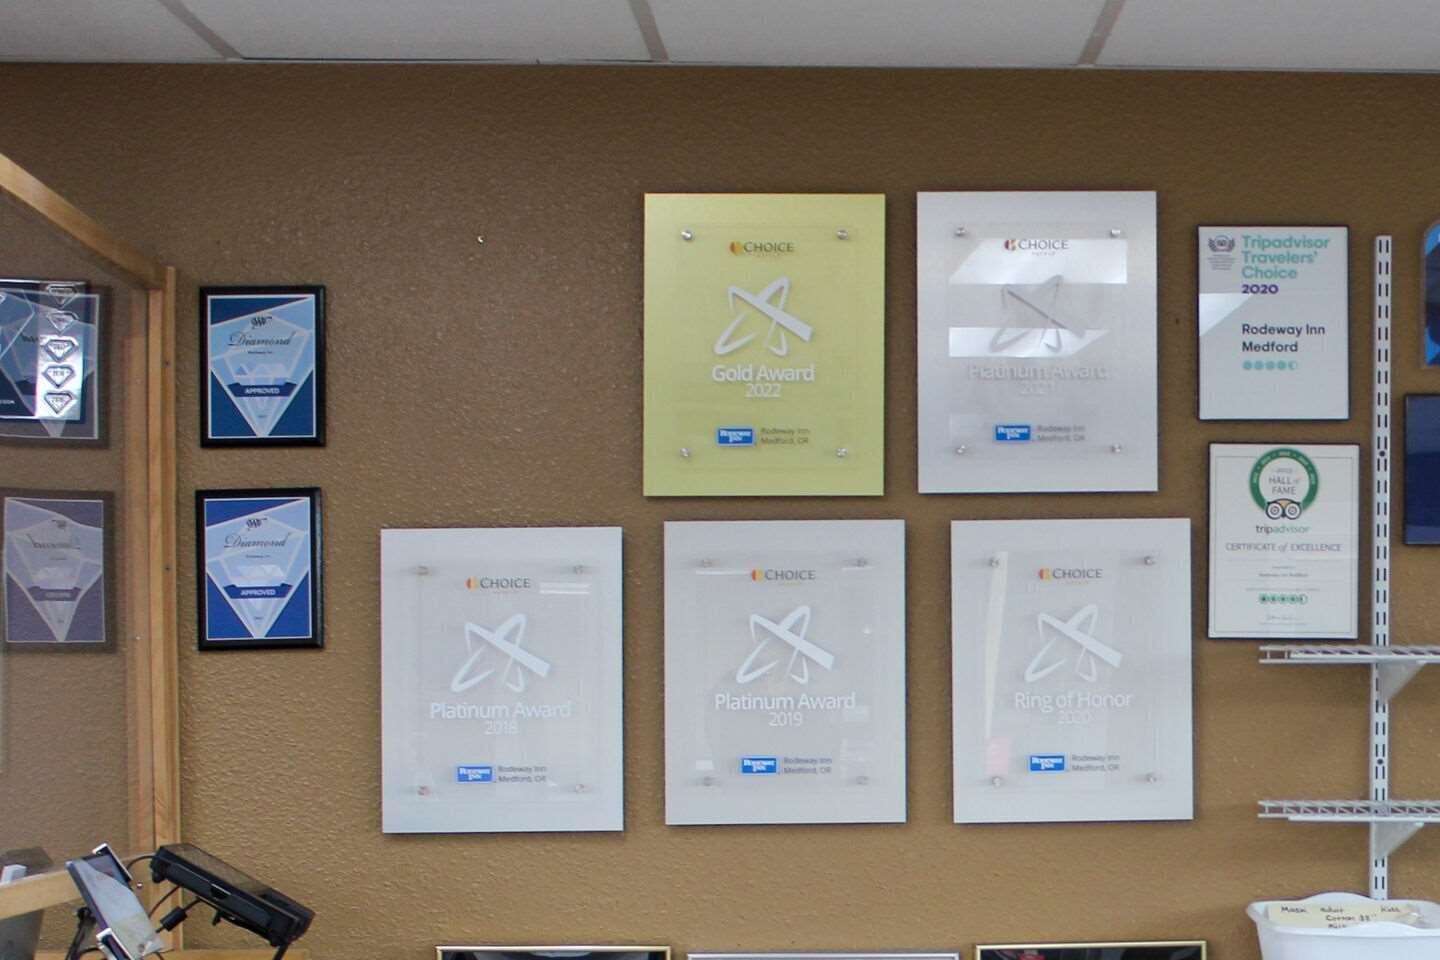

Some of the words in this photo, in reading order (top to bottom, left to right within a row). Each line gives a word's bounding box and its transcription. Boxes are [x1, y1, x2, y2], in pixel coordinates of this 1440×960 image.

[743, 241, 795, 253] CHOICE
[1018, 239, 1069, 250] CHOICE
[1241, 234, 1331, 250] Tripadvisor
[1241, 250, 1319, 264] Travelers'
[1241, 266, 1298, 279] Choice
[1241, 284, 1279, 294] 2020
[1241, 323, 1302, 337] Rodeway
[1305, 323, 1326, 335] Inn
[228, 331, 298, 347] Diamond
[1241, 341, 1298, 352] Medford
[711, 364, 752, 381] Gold
[756, 364, 815, 381] Award
[244, 387, 280, 395] APPROVED
[745, 383, 781, 397] 2022
[1268, 476, 1293, 485] HALL
[1272, 486, 1297, 495] FAME
[1256, 523, 1310, 535] tripadvisor
[224, 532, 293, 549] Diamond
[1225, 542, 1276, 551] CERTIFICATE
[1290, 543, 1341, 552] EXCELLENCE
[764, 569, 816, 580] CHOICE
[1052, 568, 1103, 579] CHOICE
[480, 577, 531, 589] CHOICE
[240, 588, 276, 596] APPROVED
[714, 693, 794, 711] Platinum
[798, 692, 856, 710] Award
[1015, 692, 1053, 713] Ring
[1055, 692, 1073, 708] of
[1077, 692, 1134, 708] Honor
[429, 702, 510, 719] Platinum
[512, 701, 571, 719] Award
[768, 712, 803, 727] 2019
